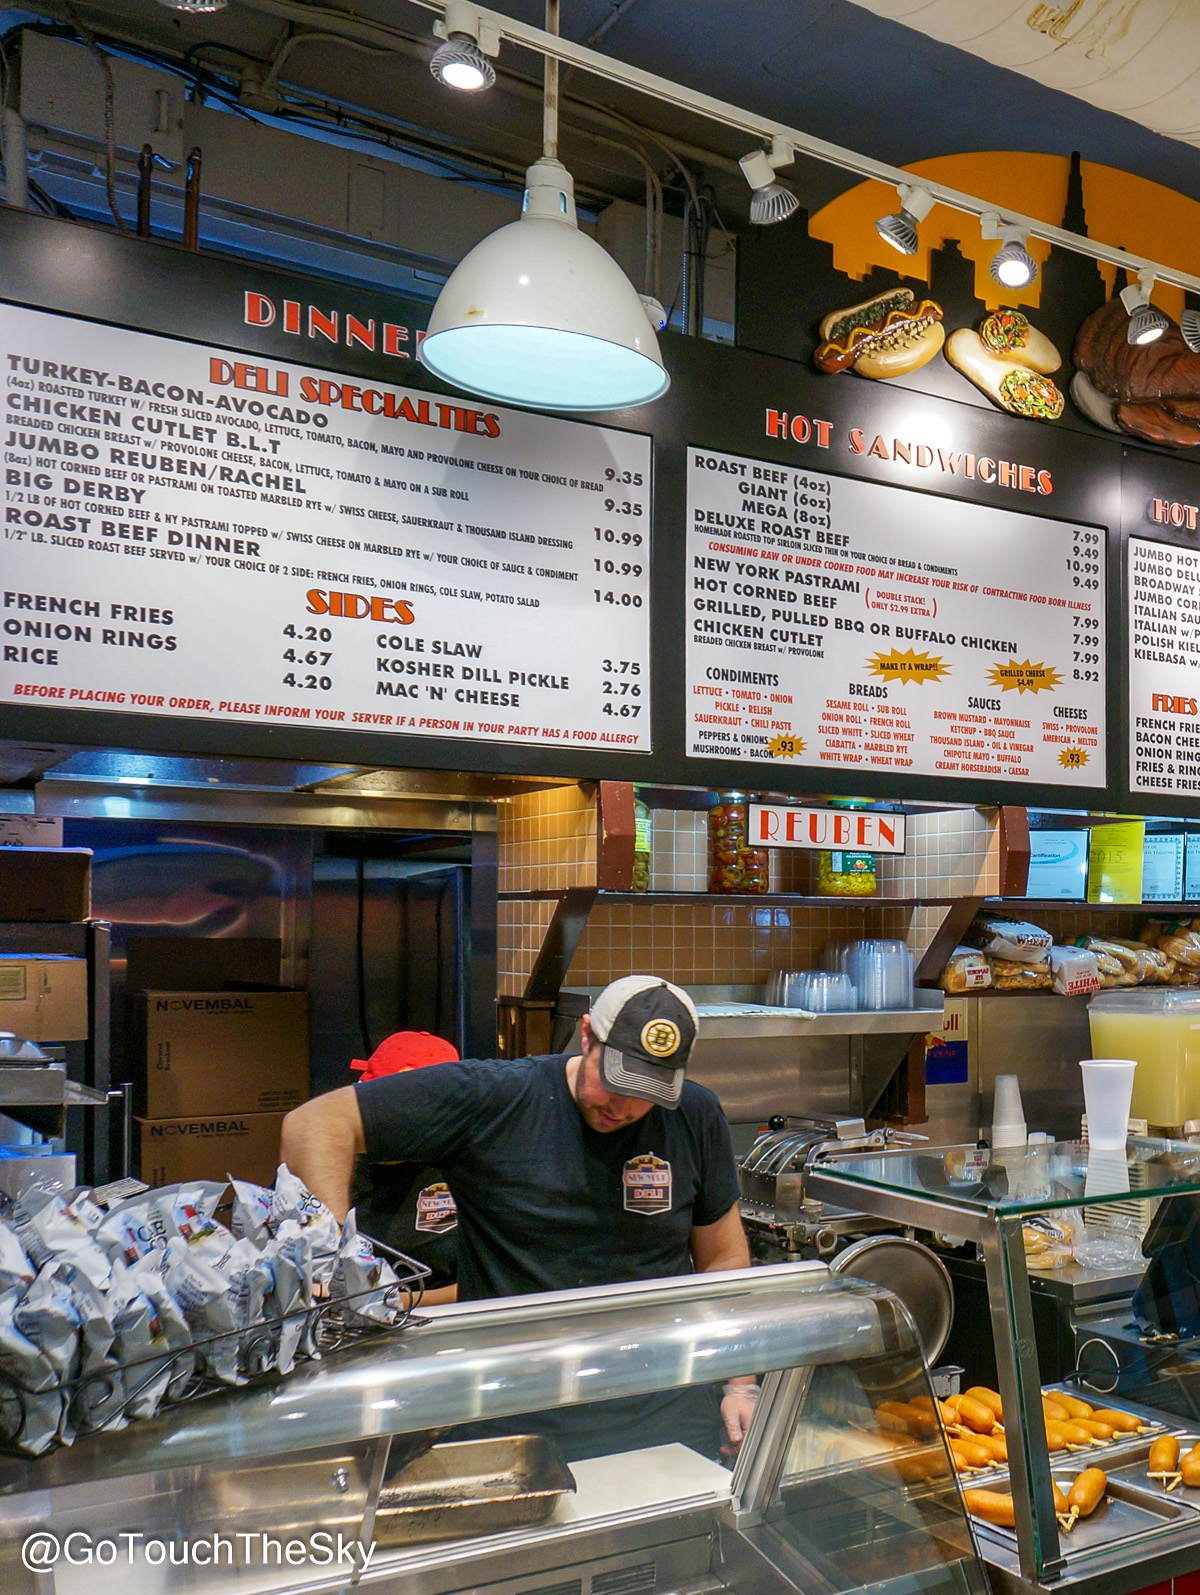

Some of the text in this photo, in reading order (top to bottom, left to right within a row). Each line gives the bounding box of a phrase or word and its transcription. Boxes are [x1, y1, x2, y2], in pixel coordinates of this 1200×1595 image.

[7, 354, 328, 428] TURKEY-BACON-AVOCADO
[209, 357, 501, 438] DELI SPECIALTIES
[7, 393, 280, 454] CHICKEN CUTLET B.L.T
[765, 408, 1054, 495] HOT SANDWICHES
[4, 431, 306, 494] JUMBO REUBEN/RACHEL
[605, 468, 643, 486] 9.35
[695, 455, 831, 496] ROAST BEEF (4oz)
[6, 469, 146, 504] BIG DERBY
[604, 498, 642, 516] 9.35
[738, 481, 831, 513] GIANT (6oz)
[742, 499, 831, 530] MEGA (8oz)
[1152, 498, 1199, 530] HOT
[6, 507, 260, 557] ROAST BEEF DINNER
[594, 527, 642, 547] 10.99
[695, 509, 849, 547] DELUXE ROAST BEEF
[1073, 530, 1099, 545] 7.99
[1066, 559, 1099, 574] 10.99
[1133, 546, 1172, 563] JUMBO
[1177, 555, 1198, 567] HOT
[594, 558, 642, 577] 10.99
[694, 556, 859, 593] NEW YORK PASTRAMI
[694, 577, 837, 609] HOT CORNED BEEF
[1134, 575, 1195, 595] BROADWAY
[4, 591, 173, 625] FRENCH FRIES
[305, 588, 416, 625] SIDES
[594, 589, 642, 608] 14.00
[1134, 604, 1177, 621] ITALIAN
[3, 619, 177, 651] ONION RINGS
[283, 624, 332, 642] 4.20
[694, 619, 823, 647] CHICKEN CUTLET
[1134, 634, 1174, 649] POLISH
[4, 645, 58, 665] RICE
[377, 634, 482, 658] COLE SLAW
[283, 648, 333, 666] 4.67
[1134, 648, 1186, 665] KIELBASA
[377, 658, 569, 690] KOSHER DILL PICKLE
[602, 659, 640, 675] 3.75
[706, 667, 779, 687] CONDIMENTS
[283, 673, 332, 690] 4.20
[602, 681, 641, 697] 2.76
[849, 683, 888, 698] BREADS
[376, 681, 519, 707] MAC 'N' CHEESE
[693, 685, 793, 704] LETTUCE TOMATO ONION
[968, 696, 1001, 711] SAUCES
[13, 684, 639, 744] BEFORE PLACING YOUR ORDER, PLEASE INFORM YOUR SERVER IF A PERSON IN YOUR PARTY HAS A FOOD ALLERGY
[602, 703, 641, 718] 4.67
[1053, 706, 1087, 720] CHEESES
[1151, 692, 1198, 717] FRIES
[1136, 717, 1175, 731] FRENCH
[777, 741, 794, 752] .93
[1136, 775, 1172, 788] CHEESE
[760, 810, 895, 847] REUBEN
[1090, 850, 1123, 863] 2015
[1016, 935, 1049, 948] WHEAT
[1067, 976, 1099, 990] WHITE
[156, 998, 254, 1012] NOVEMBAL
[151, 1120, 249, 1137] NOVEMBAL
